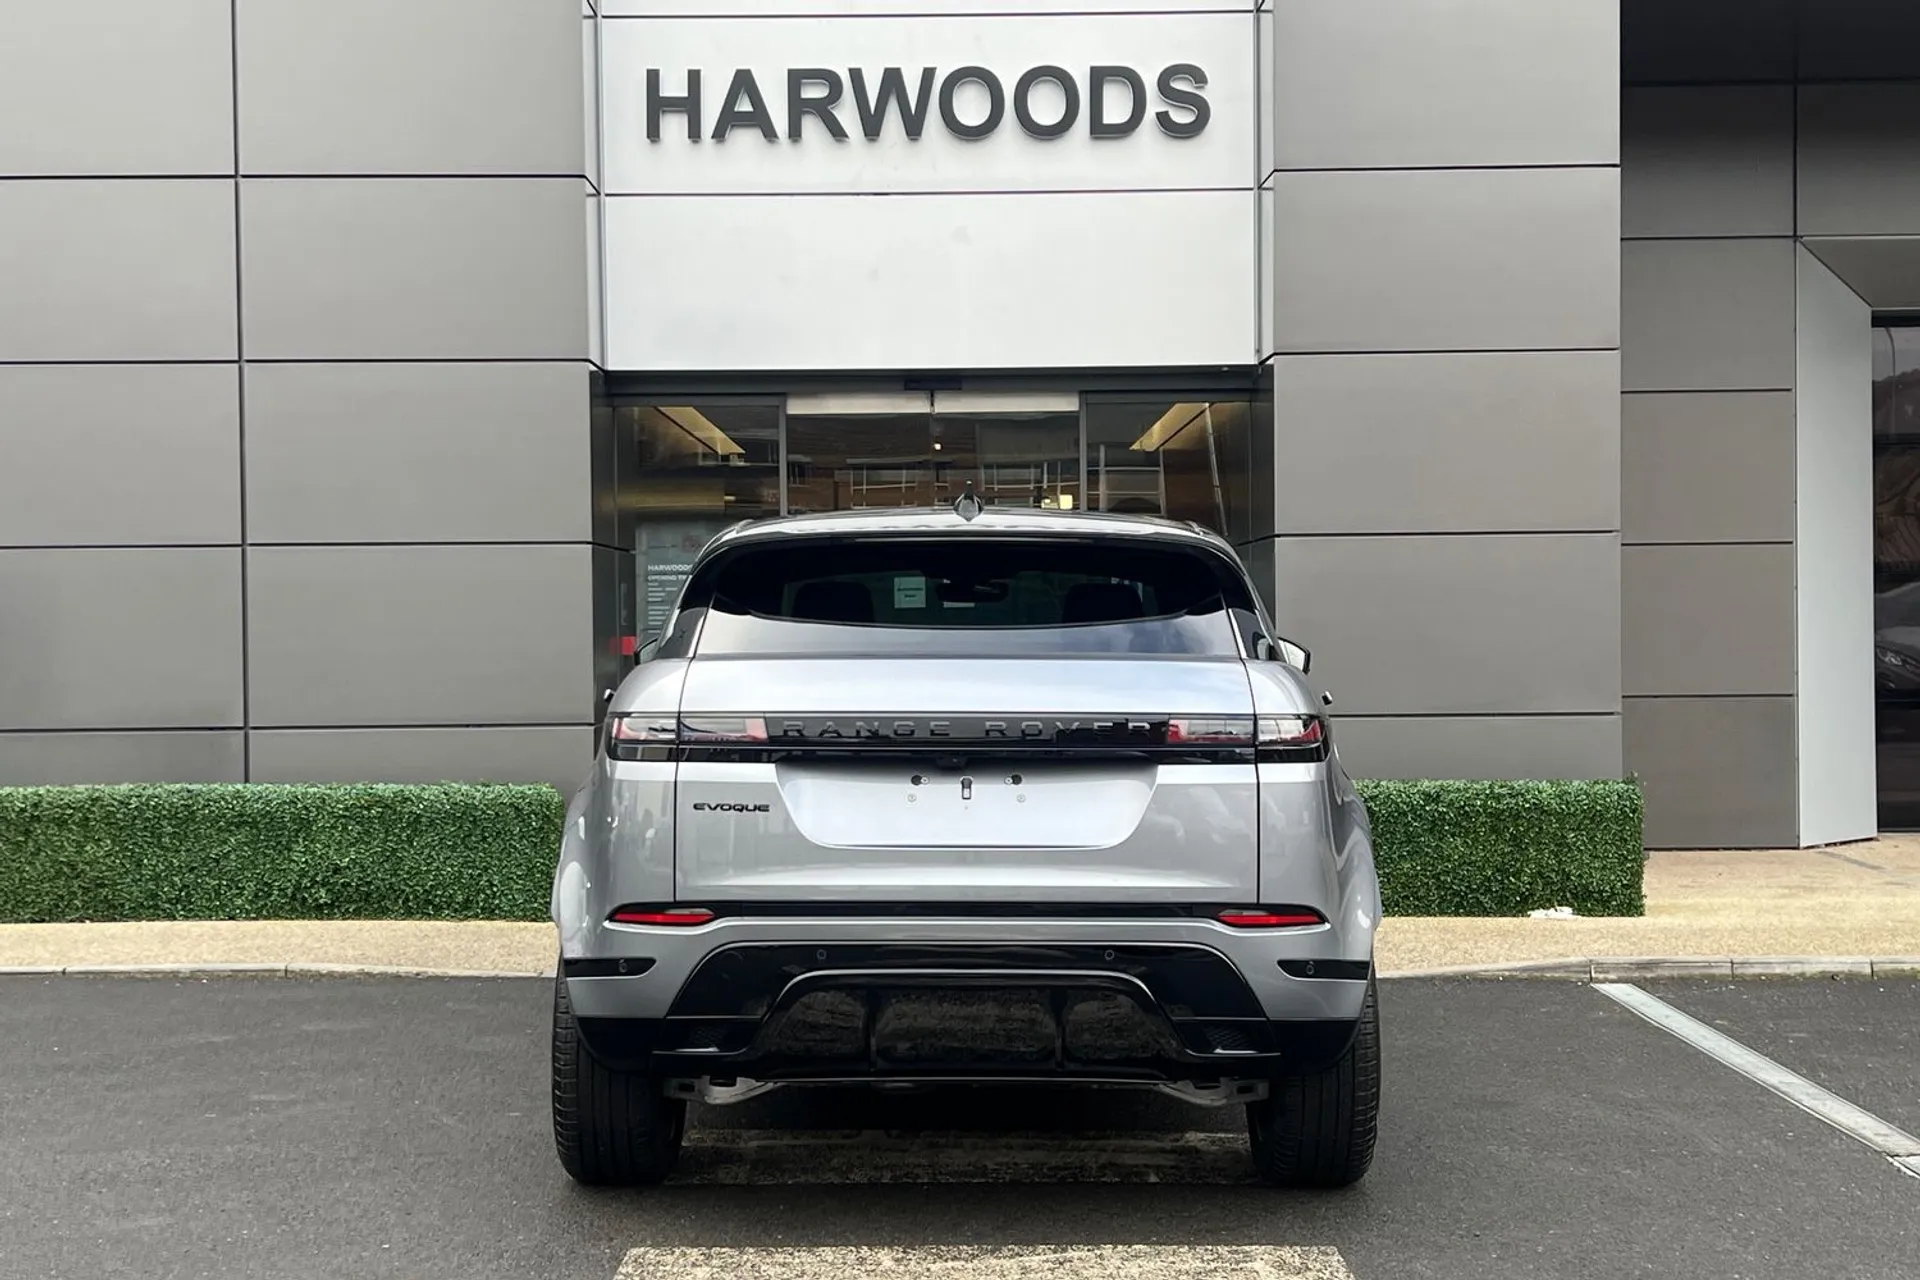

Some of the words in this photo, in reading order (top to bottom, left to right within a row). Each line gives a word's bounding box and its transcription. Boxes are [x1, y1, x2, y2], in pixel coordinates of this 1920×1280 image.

[646, 63, 1211, 143] HARWOODS
[782, 720, 950, 738] RANGE
[985, 720, 1152, 738] ROVER
[692, 802, 770, 813] EVOQUE
